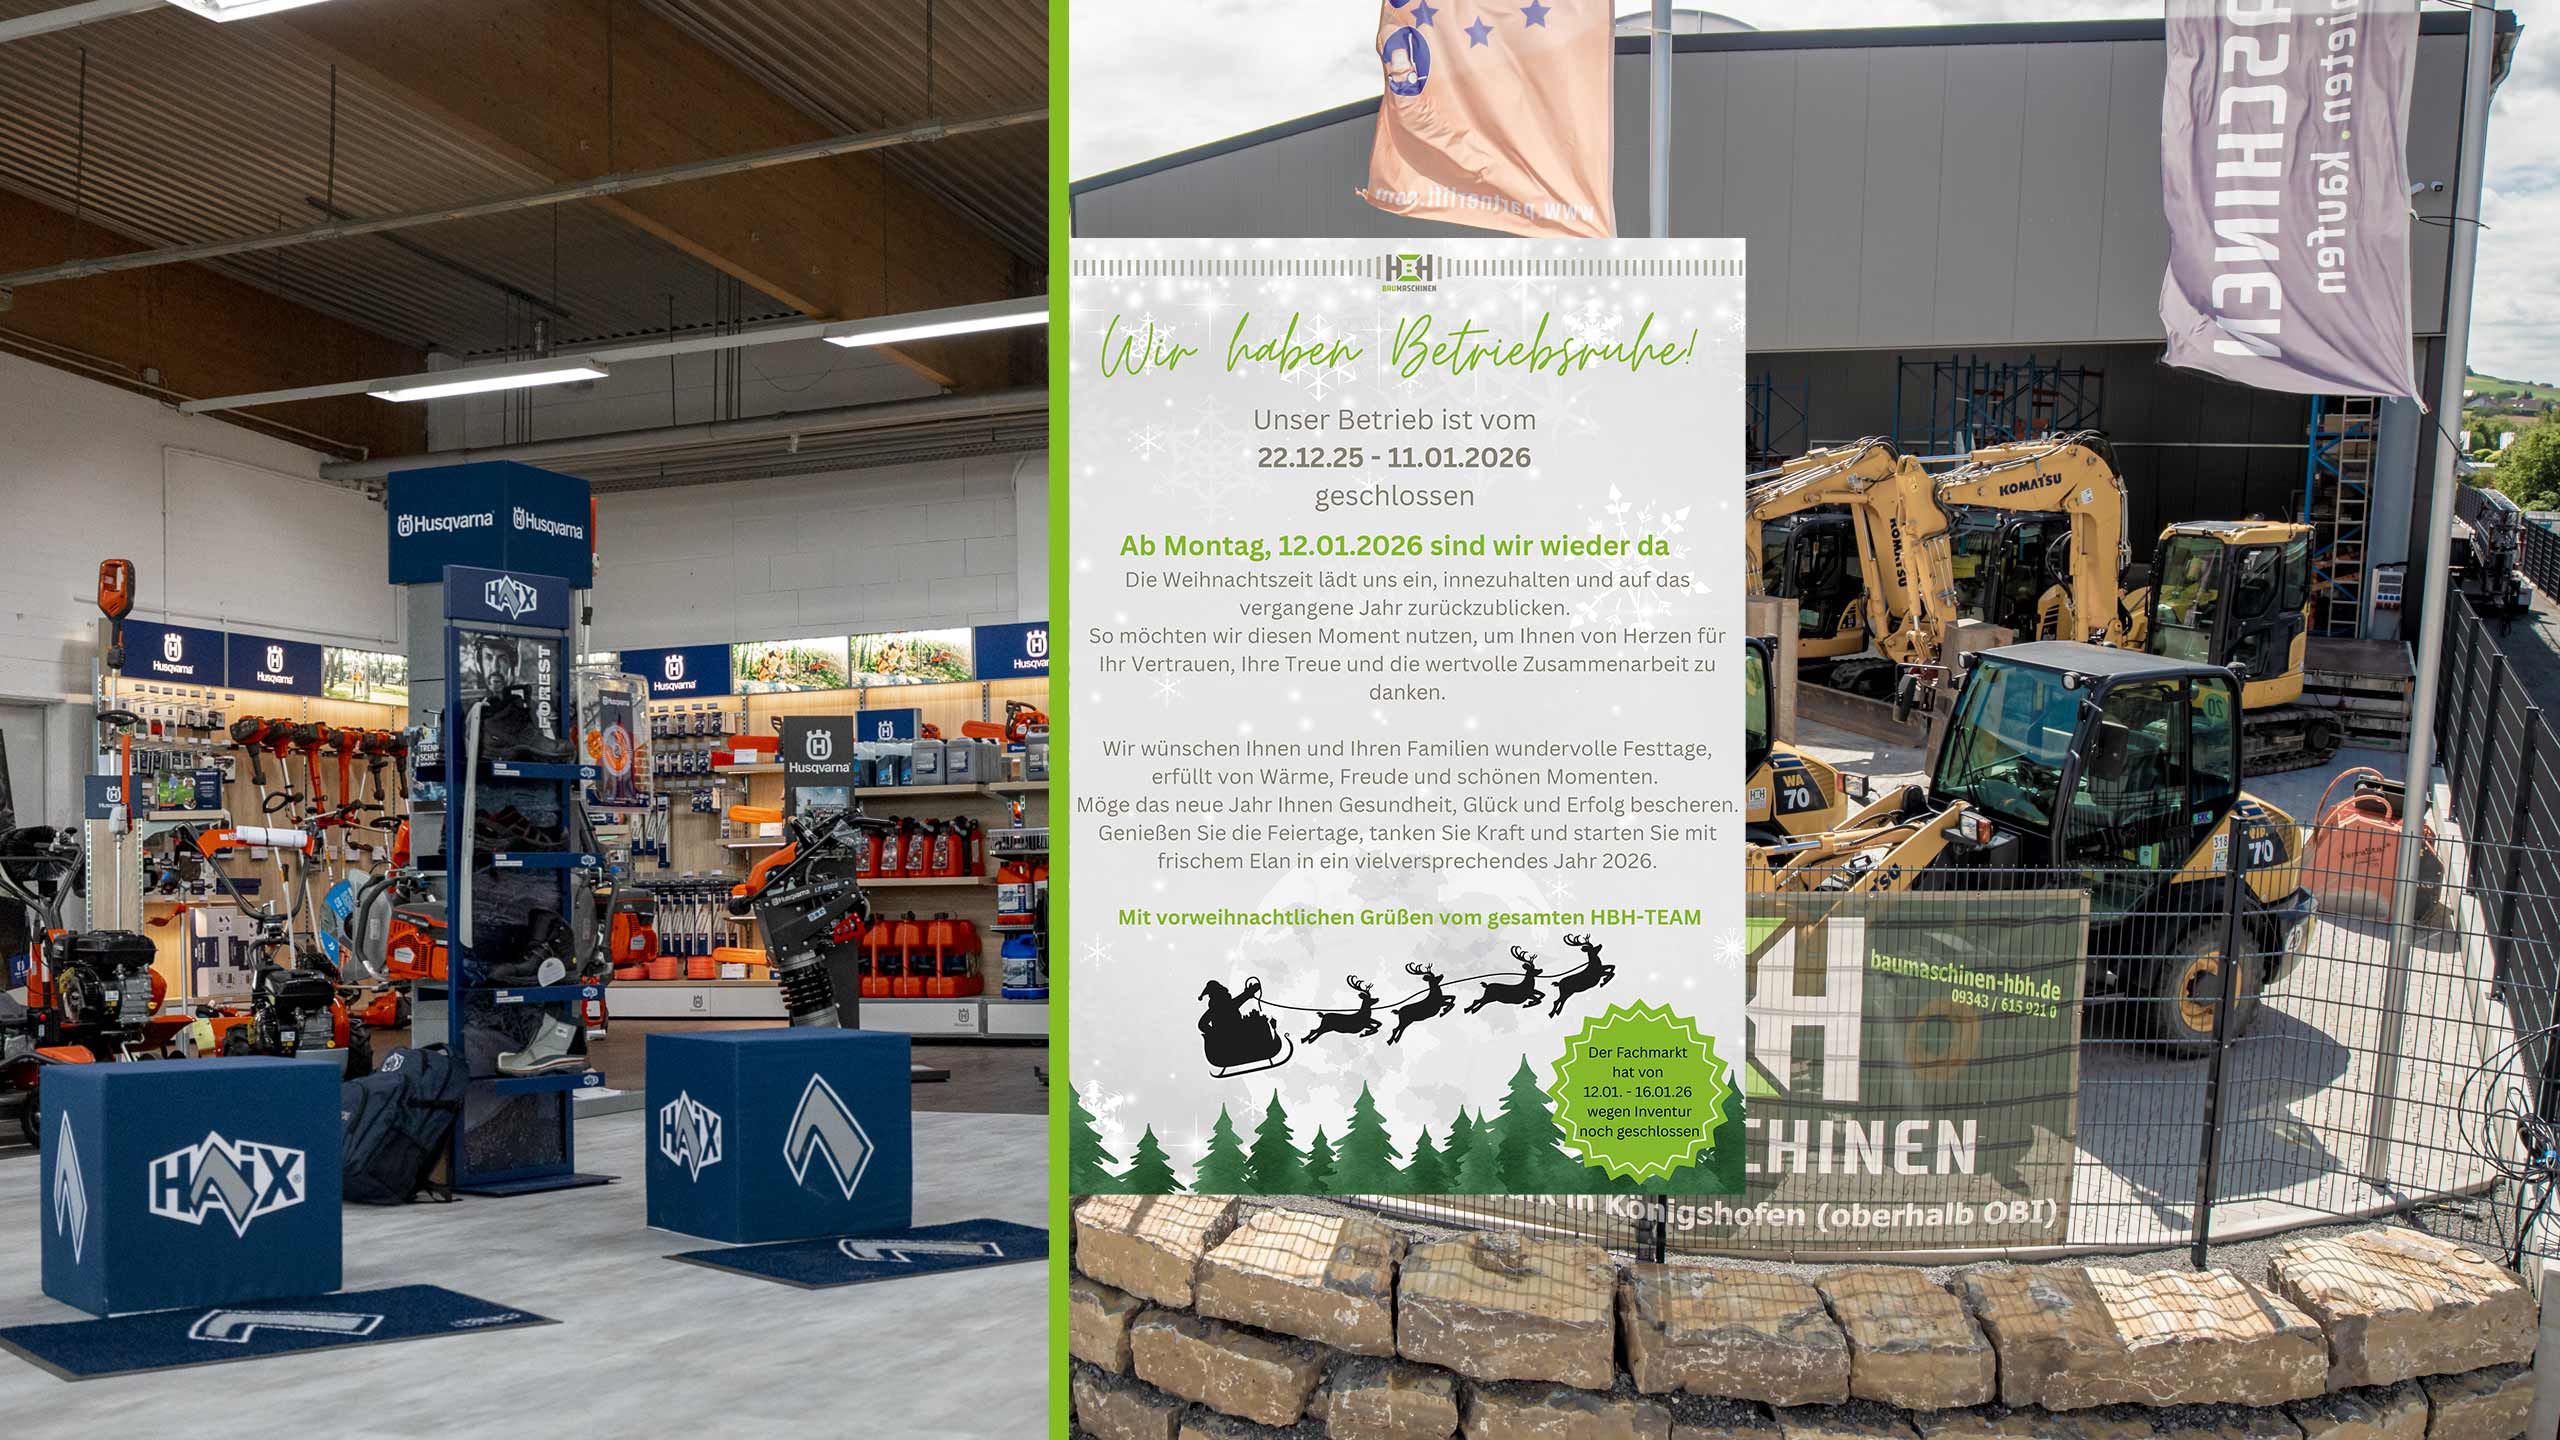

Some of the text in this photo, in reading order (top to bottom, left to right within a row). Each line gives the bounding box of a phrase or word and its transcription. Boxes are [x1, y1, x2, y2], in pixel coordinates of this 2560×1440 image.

[2000, 473, 2062, 496] KOMATSU
[415, 512, 494, 532] Husqvarna
[525, 512, 583, 540] Husqvarna
[153, 660, 193, 674] Husqvarna
[256, 671, 293, 685] Husqvarna
[538, 645, 551, 729] FOREST
[654, 681, 696, 692] Husqvarna
[789, 762, 850, 774] Husqvarna
[1782, 774, 1805, 788] WA
[1783, 788, 1810, 809] 70
[2248, 839, 2274, 865] 70
[777, 889, 811, 903] Husqvarna
[1871, 949, 2061, 1001] baumaschinen-hbh.de
[1952, 988, 1989, 1009] 09343
[2001, 997, 2023, 1013] 615
[2027, 1001, 2047, 1017] 921
[1606, 1195, 1806, 1231] Königshofen
[1817, 1202, 1974, 1233] (oberhalb
[1983, 1199, 2057, 1228] OBI)
